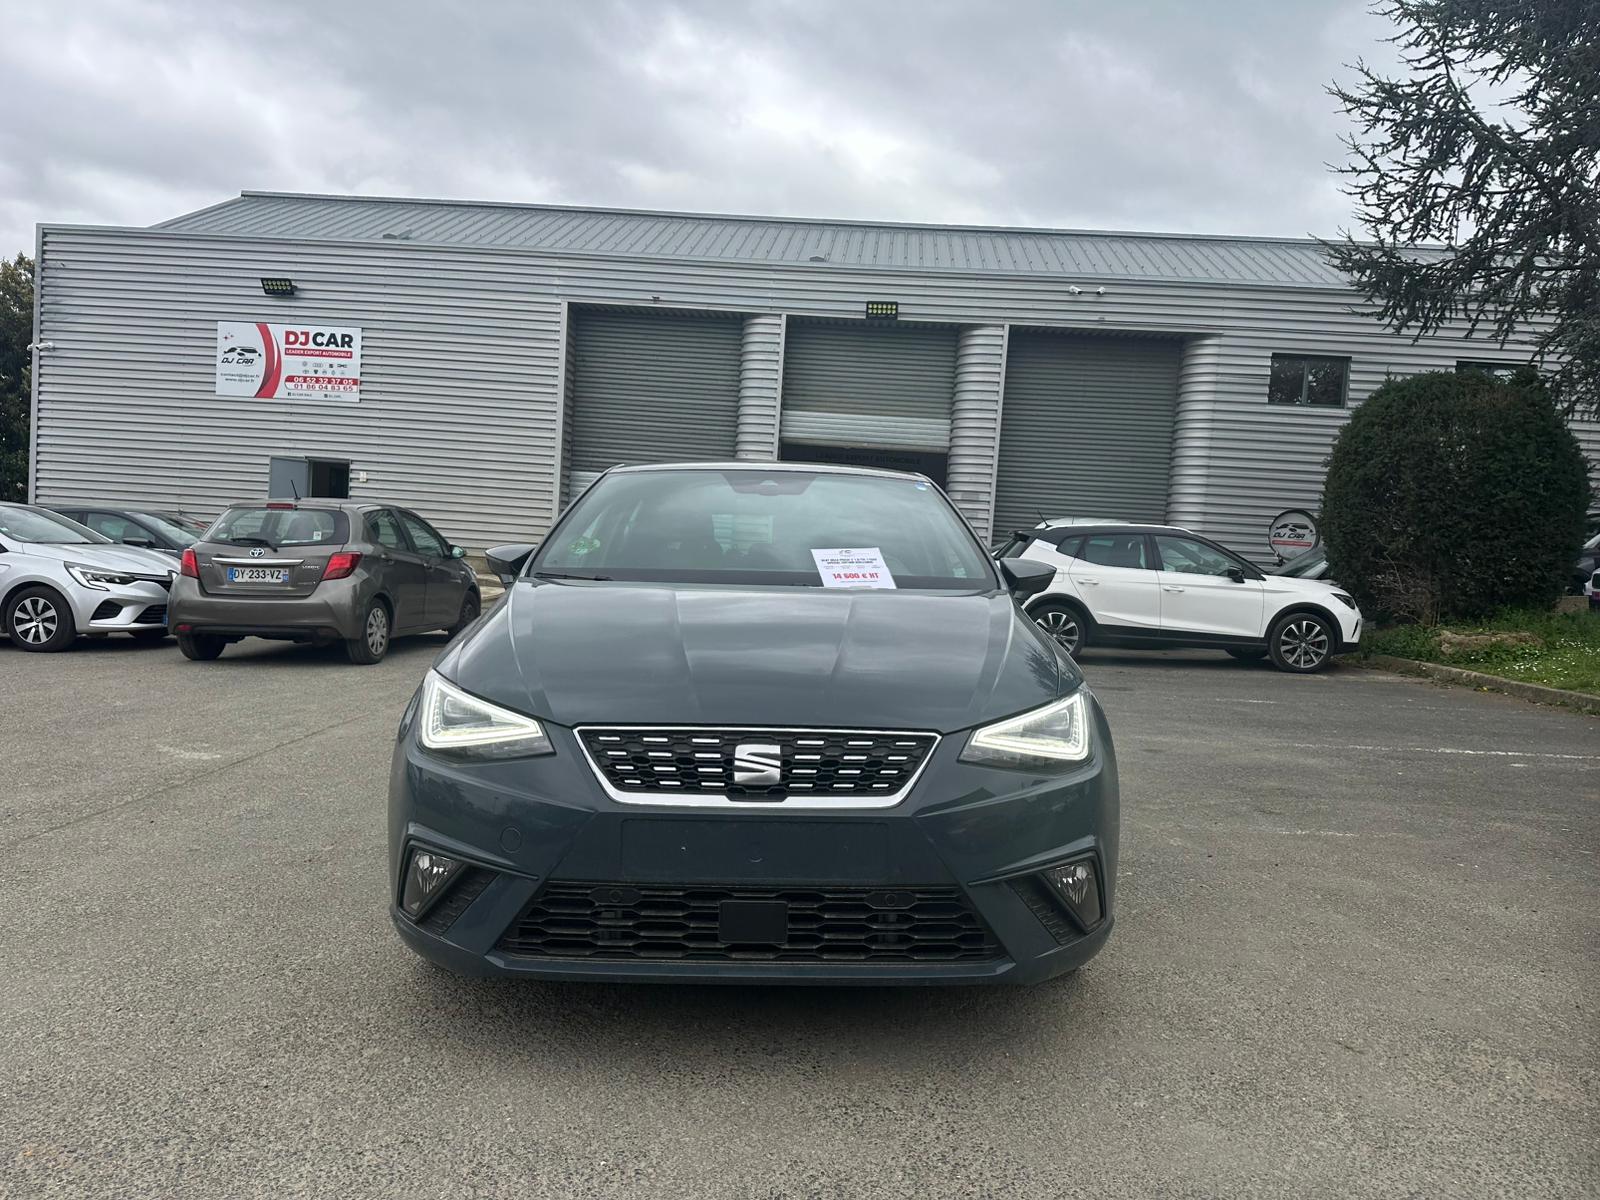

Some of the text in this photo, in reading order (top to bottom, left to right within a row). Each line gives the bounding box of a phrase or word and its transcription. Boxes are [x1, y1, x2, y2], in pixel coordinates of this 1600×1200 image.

[285, 331, 353, 348] DJ CAR
[234, 569, 281, 580] DY-233-VZ
